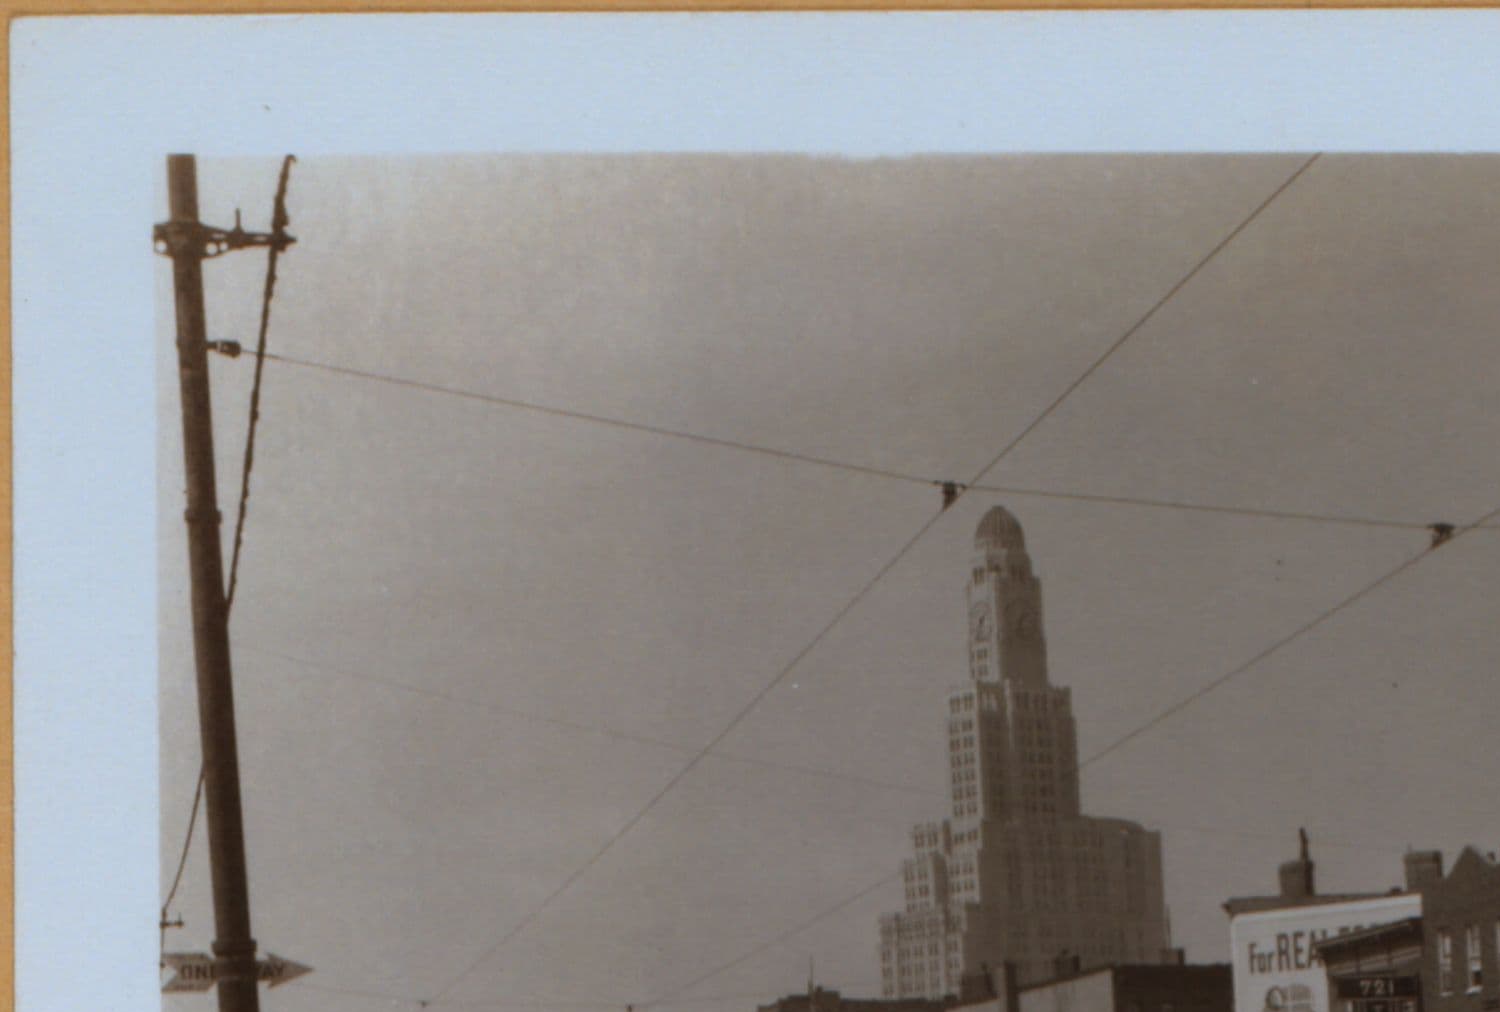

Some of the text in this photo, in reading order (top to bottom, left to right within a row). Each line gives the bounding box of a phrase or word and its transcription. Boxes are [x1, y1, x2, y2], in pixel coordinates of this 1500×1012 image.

[1247, 942, 1285, 975] For
[1276, 928, 1328, 970] REA
[1359, 979, 1395, 997] 721
